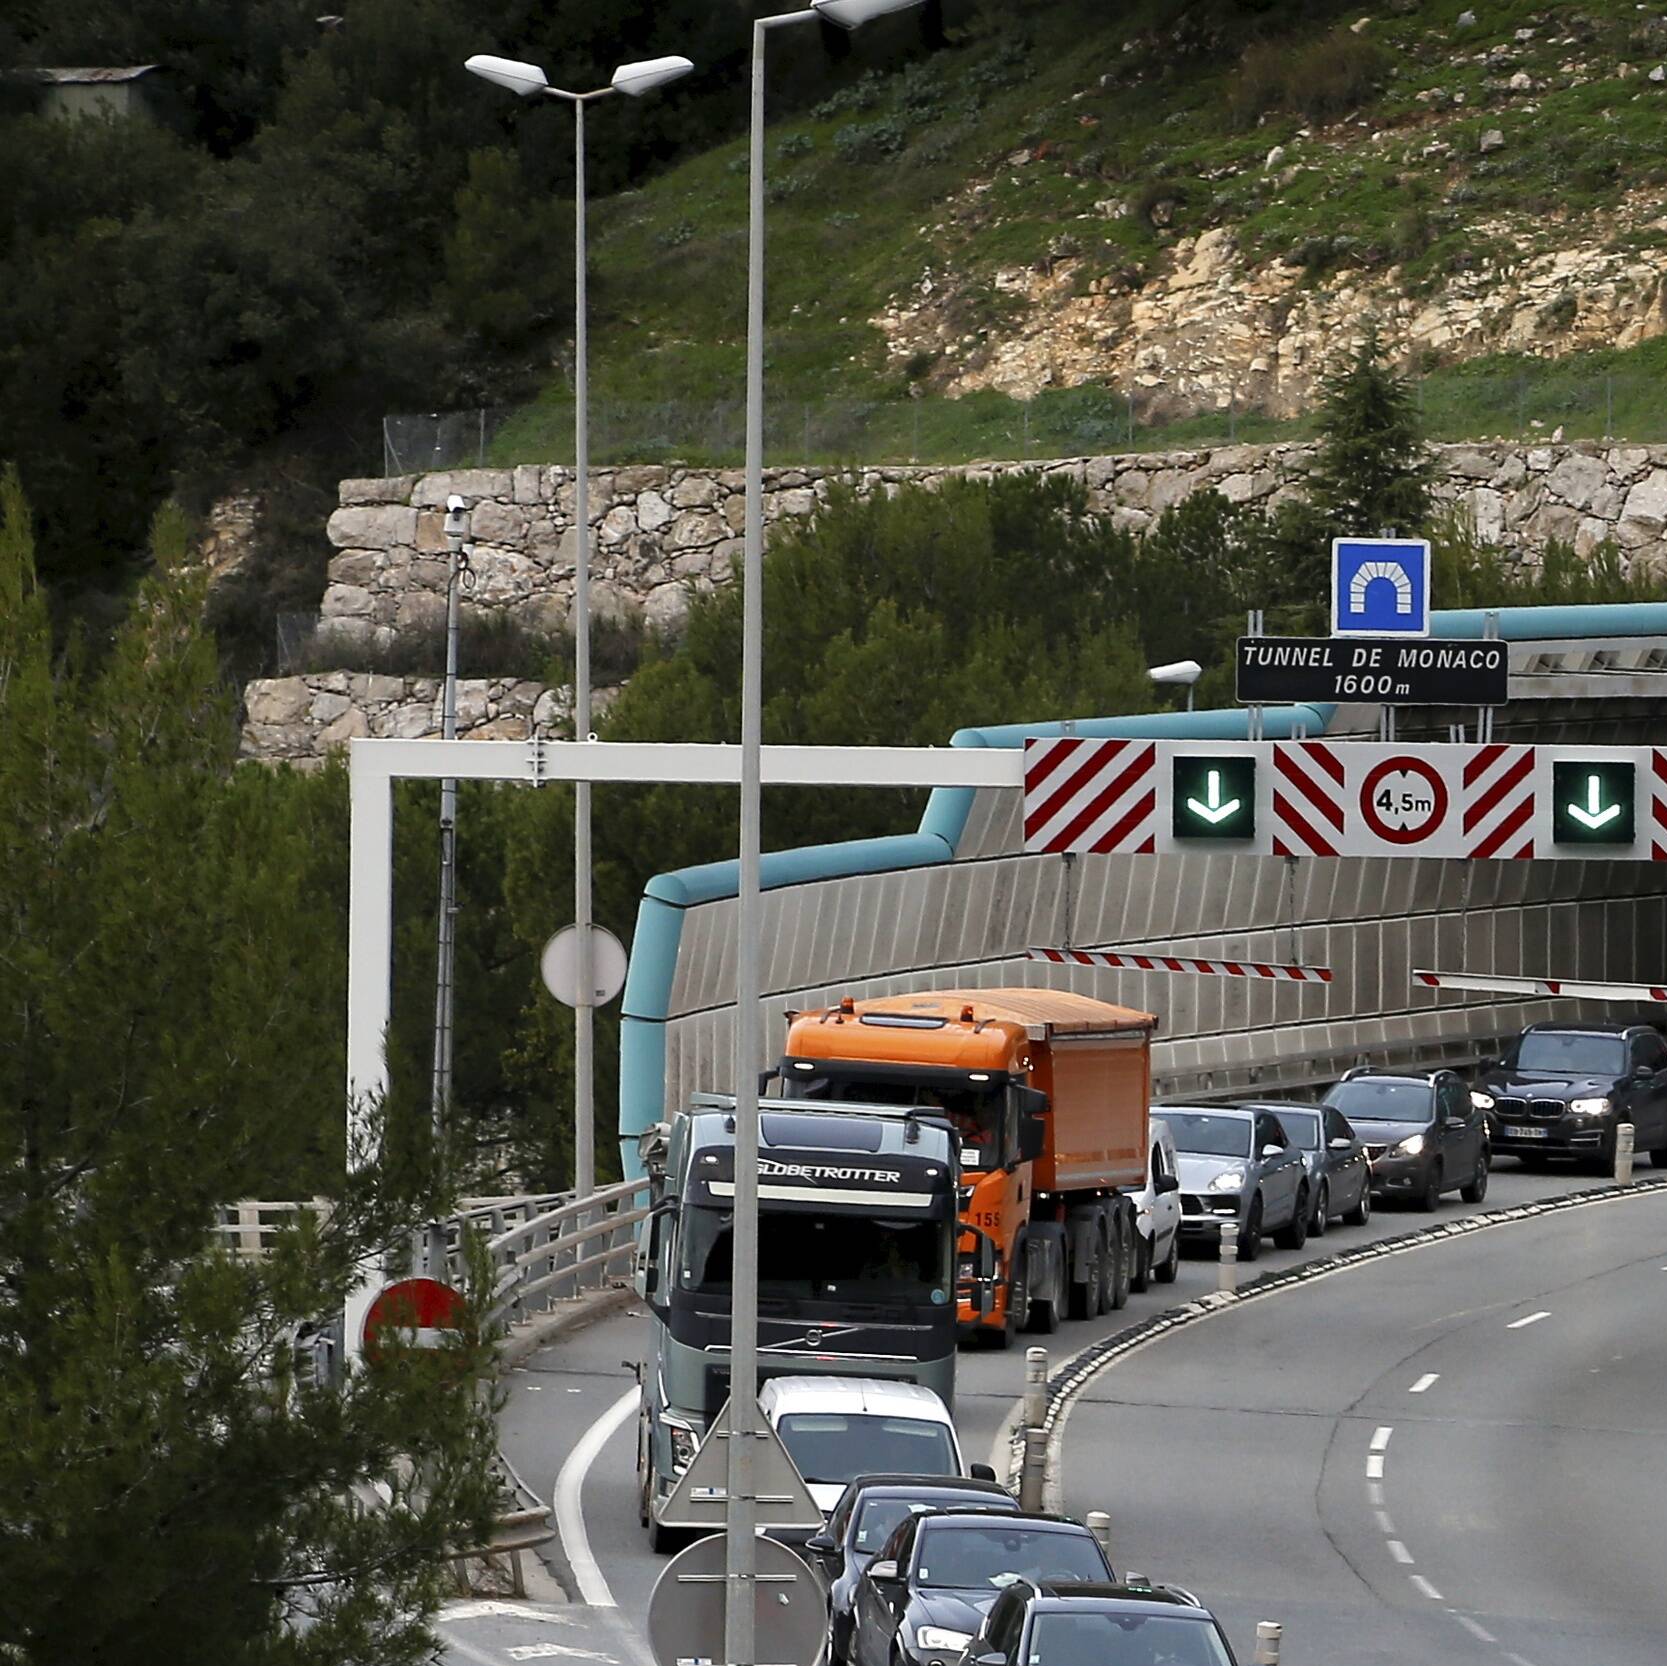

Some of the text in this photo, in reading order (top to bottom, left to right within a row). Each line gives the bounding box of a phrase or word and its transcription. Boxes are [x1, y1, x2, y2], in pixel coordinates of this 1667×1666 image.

[1243, 646, 1501, 670] TUNNEL DE MONACO
[1334, 674, 1410, 695] 1600m
[1376, 789, 1431, 815] 4,5m
